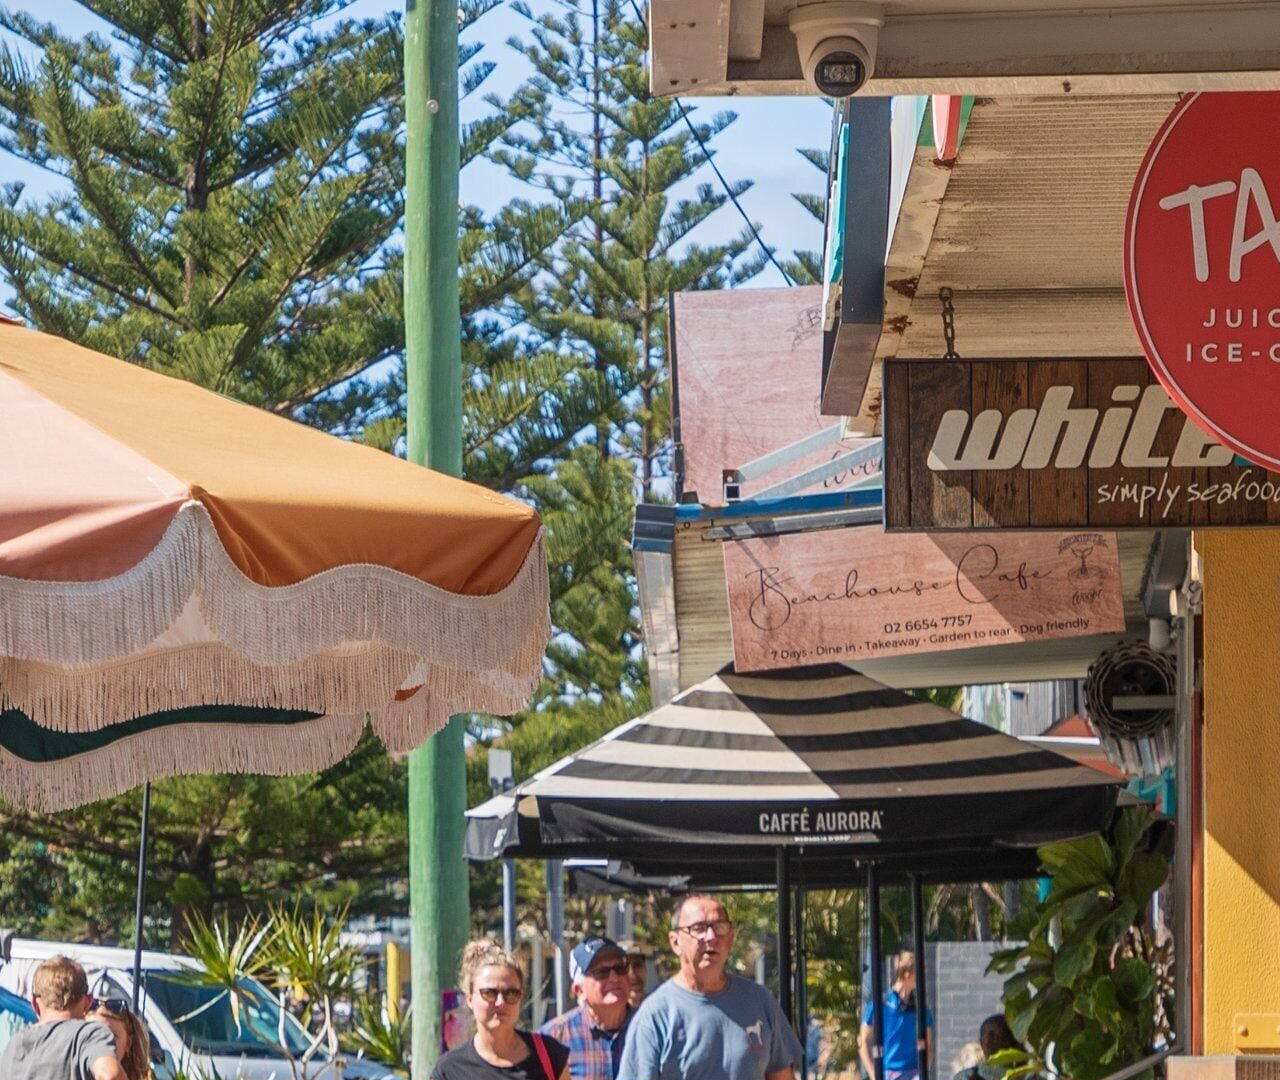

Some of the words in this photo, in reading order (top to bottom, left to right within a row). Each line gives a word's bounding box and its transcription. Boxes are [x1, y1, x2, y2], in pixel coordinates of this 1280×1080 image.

[1098, 471, 1183, 518] simply
[745, 566, 954, 631] Beachouse
[957, 544, 1053, 604] Cafe
[771, 650, 779, 660] 7
[781, 647, 808, 661] Days
[816, 644, 843, 656] Dine
[846, 642, 856, 653] in
[864, 636, 921, 652] Takeaway
[929, 631, 972, 644] Garden
[974, 629, 986, 639] to
[988, 628, 1011, 638] rear
[1020, 622, 1044, 637] Dog
[1045, 617, 1090, 632] friendly
[884, 622, 903, 635] 02
[905, 618, 938, 632] 6654
[940, 614, 973, 629] 7757
[759, 807, 810, 833] CAFFÉ
[815, 811, 882, 832] AURORA
